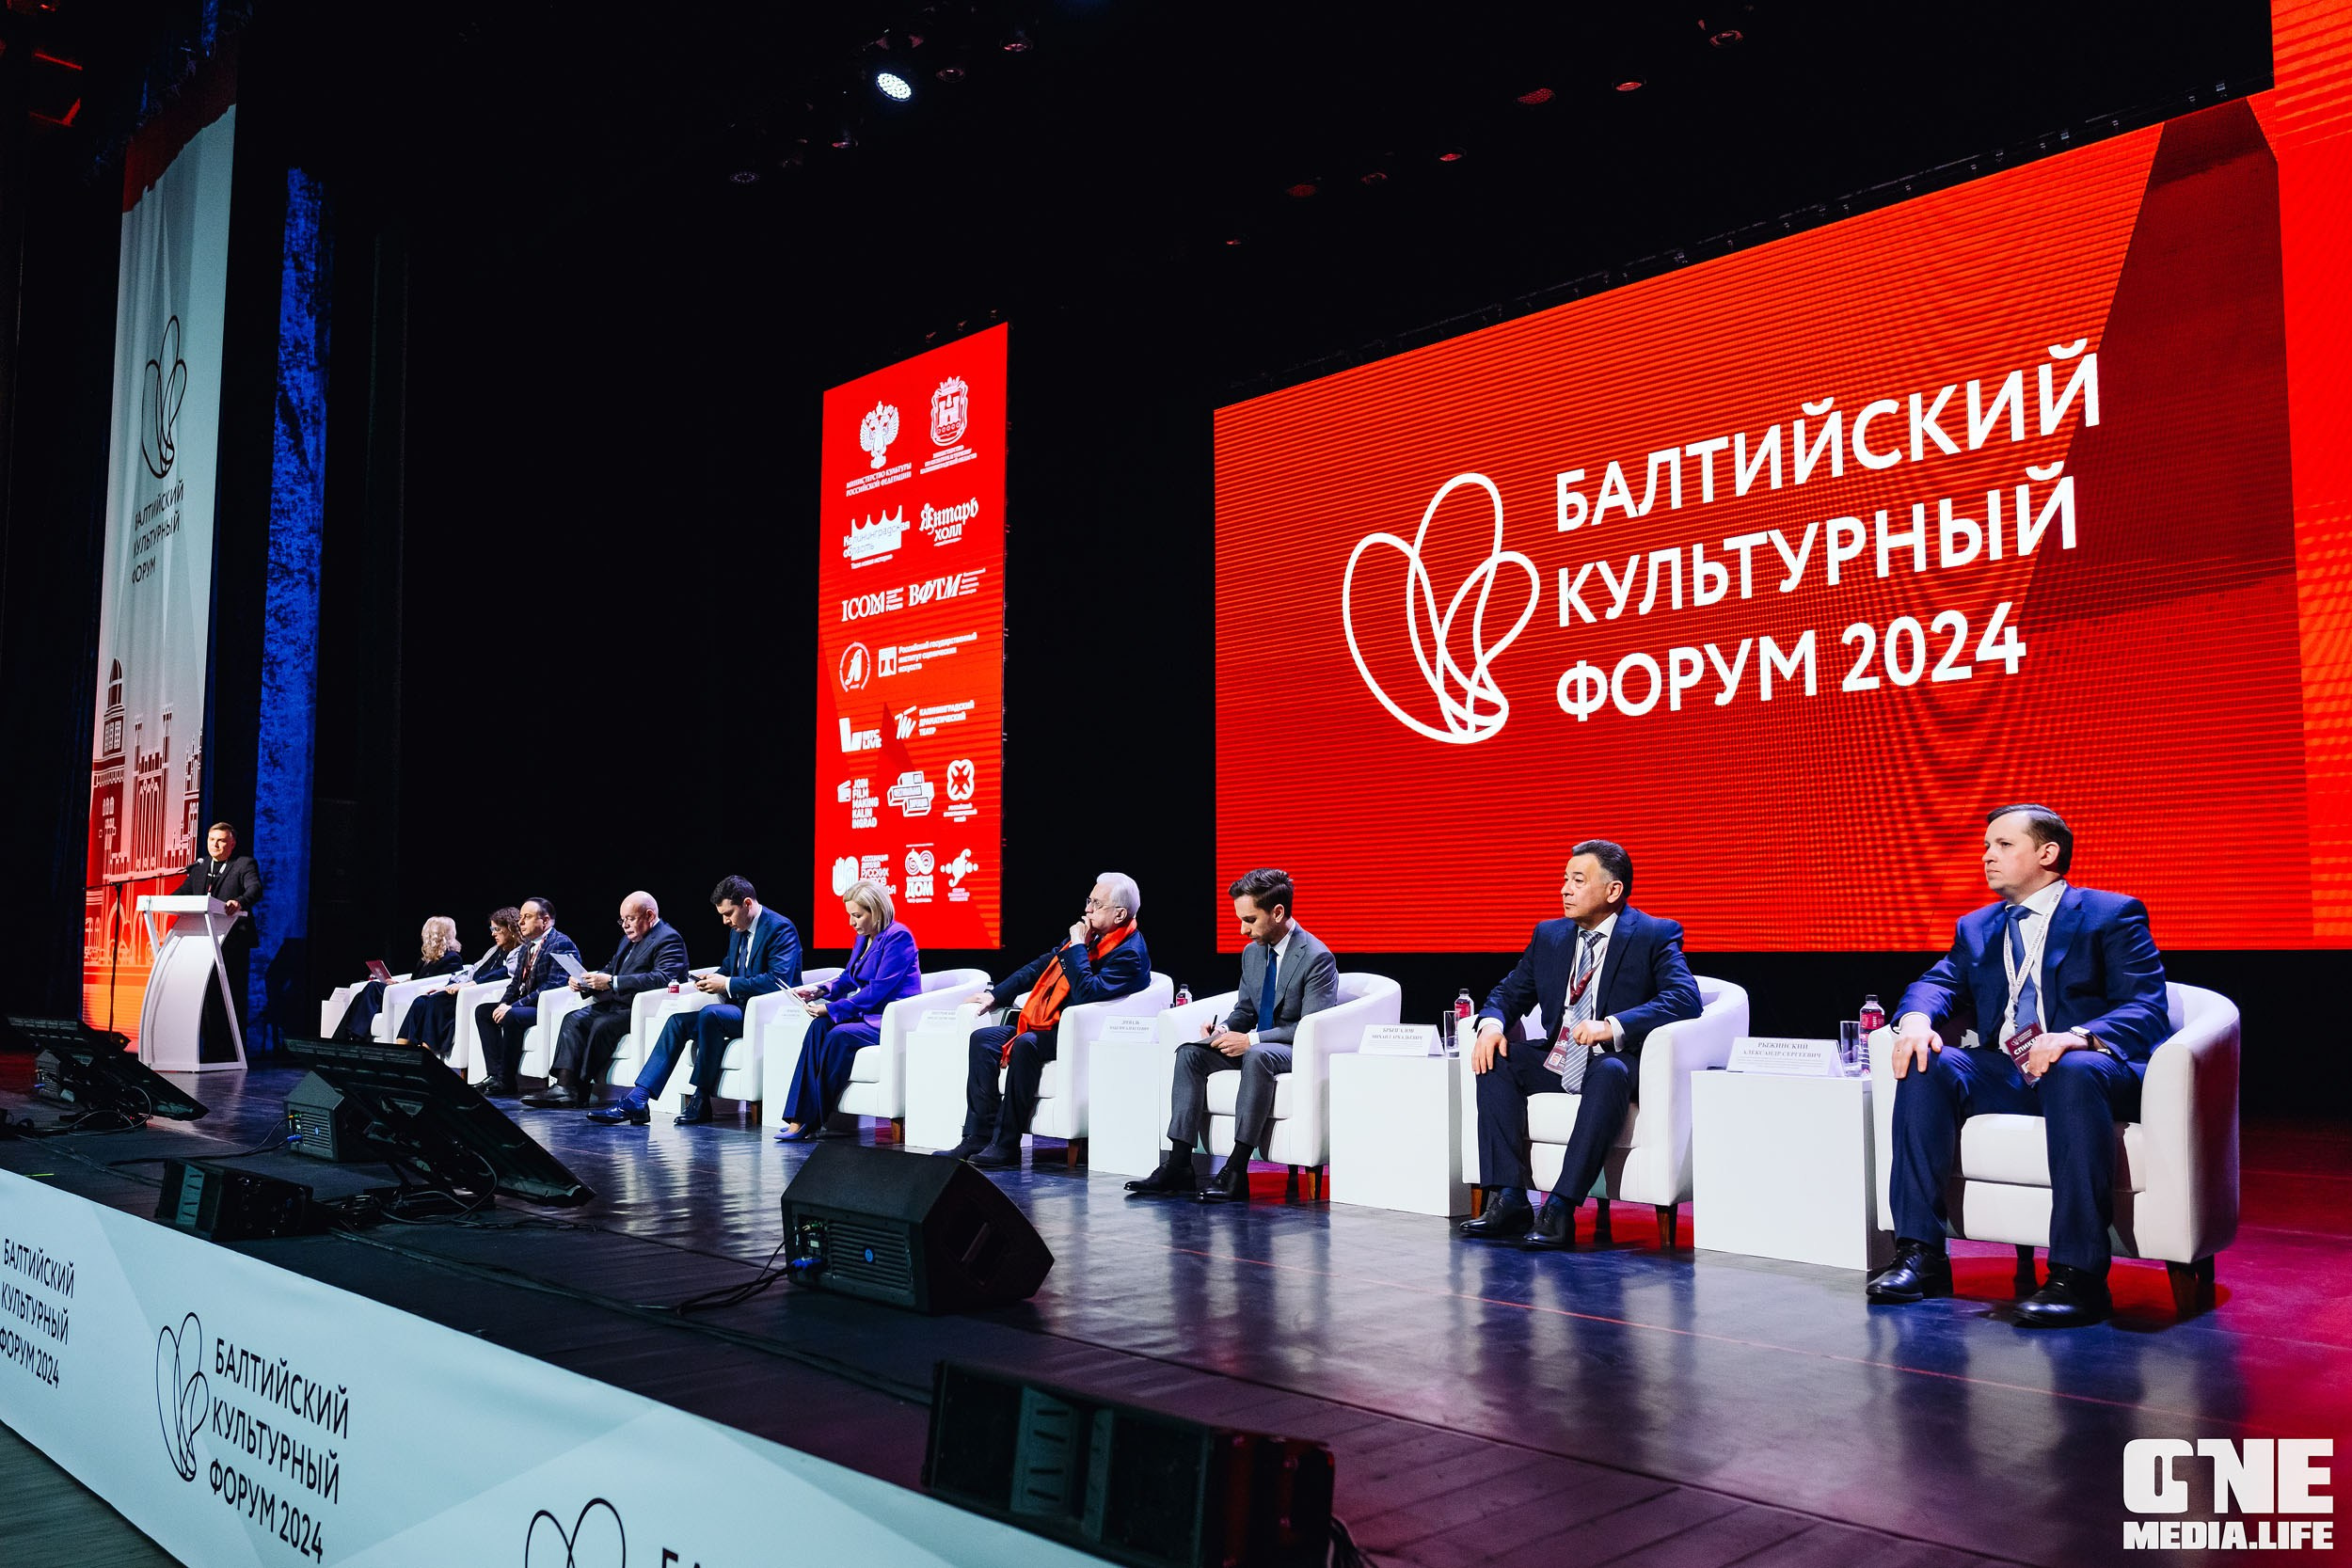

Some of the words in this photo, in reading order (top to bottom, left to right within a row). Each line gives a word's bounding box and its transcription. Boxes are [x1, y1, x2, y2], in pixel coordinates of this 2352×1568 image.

[1556, 338, 2100, 532] БАЛТИЙСКИЙ
[1557, 460, 2076, 627] КУЛЬТУРНЫЙ
[841, 591, 884, 622] ICOM
[1556, 628, 1817, 722] ФОРУМ
[1841, 602, 2026, 692] 2024
[2013, 1037, 2038, 1055] СПИКЕ
[1, 1281, 69, 1345] КУЛЬТУРНЫЙ
[4, 1238, 74, 1299] БАЛТИЙСКИЙ
[0, 1325, 35, 1372] ФОРУМ
[36, 1348, 59, 1389] 2024
[215, 1338, 349, 1439] БАЛТИЙСКИЙ
[213, 1397, 339, 1505] КУЛЬТУРНЫЙ
[209, 1458, 275, 1533] ФОРУМ
[279, 1500, 324, 1564] 2024
